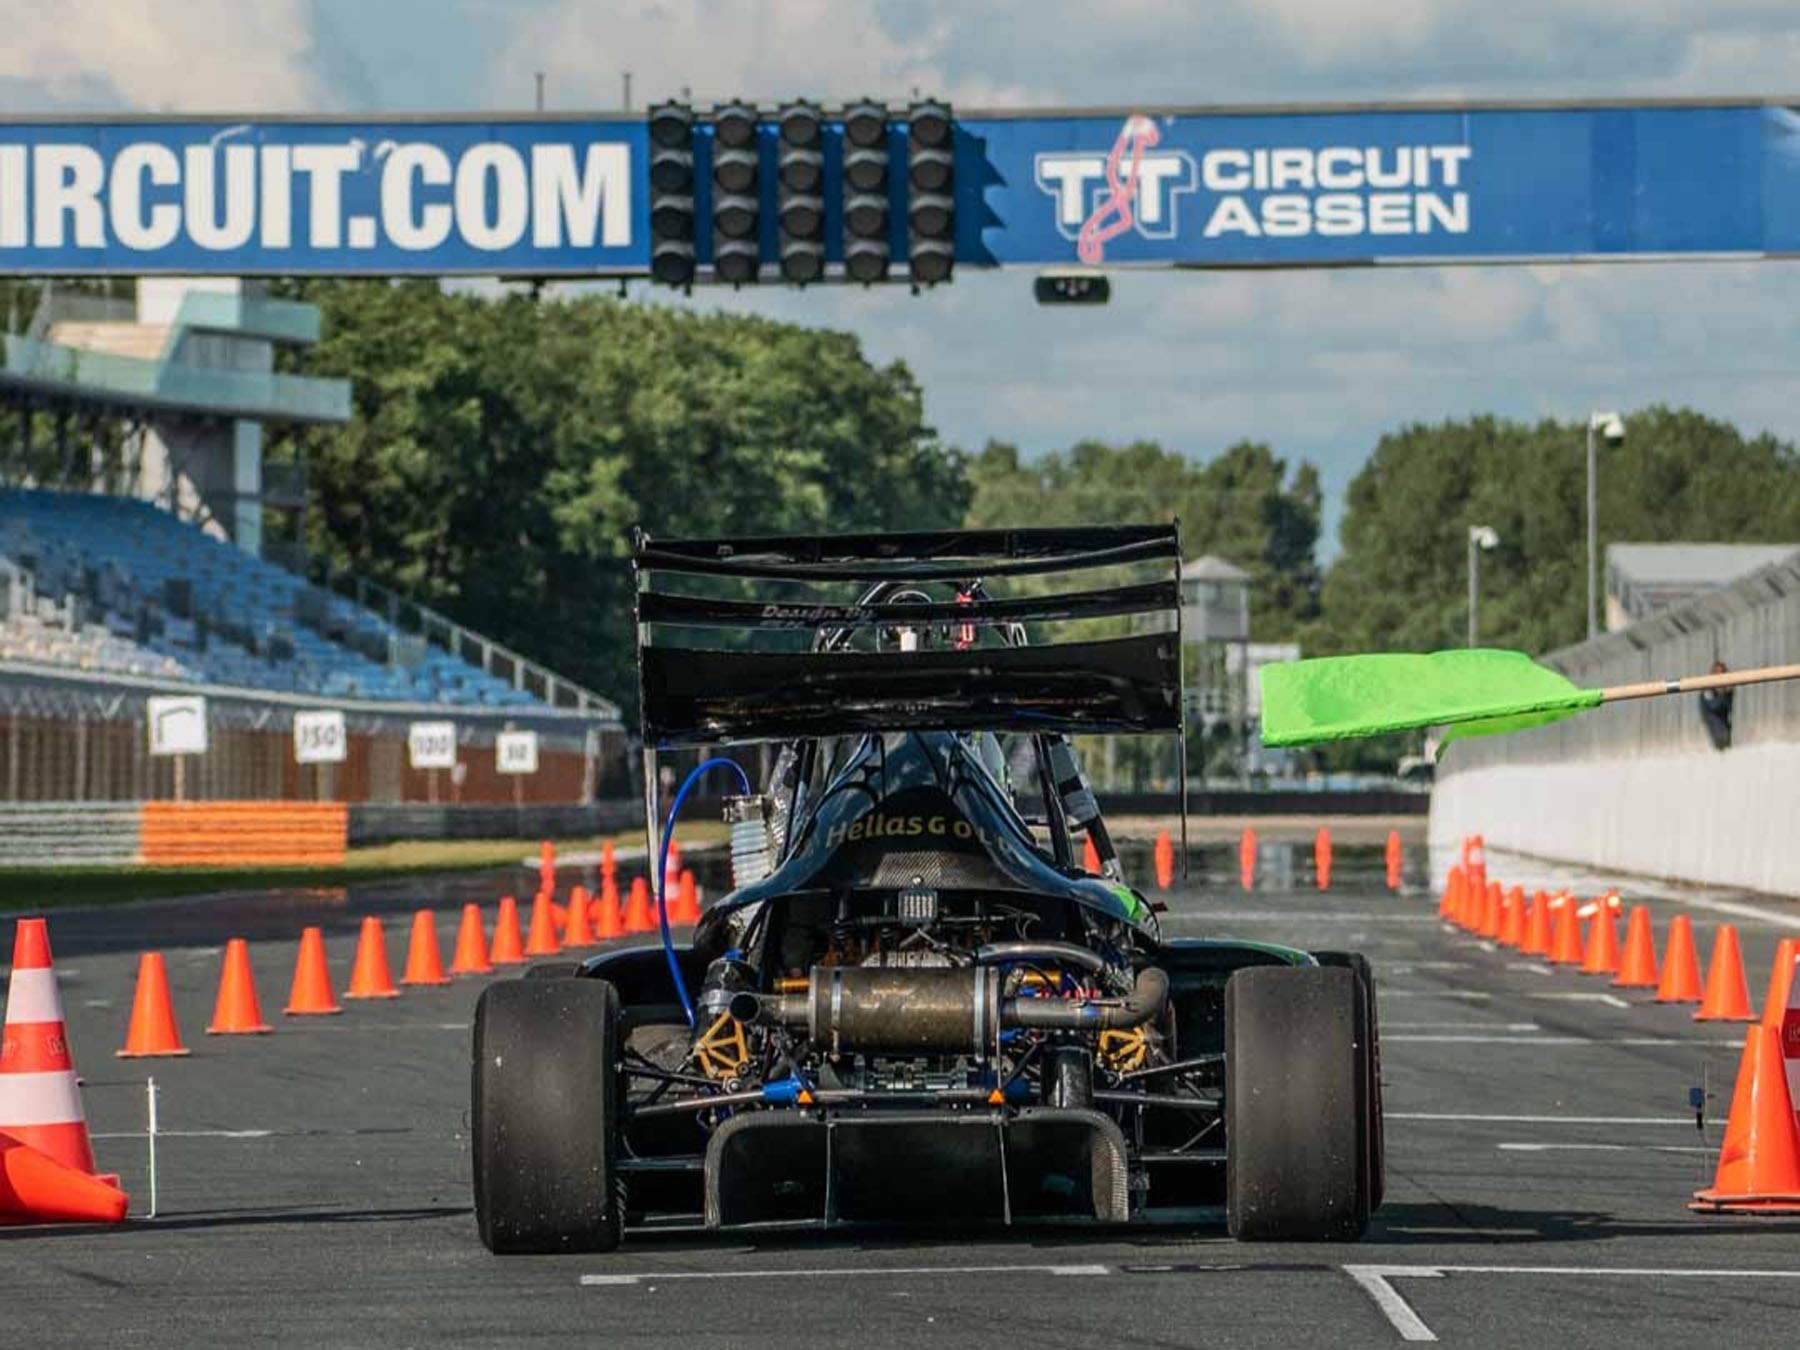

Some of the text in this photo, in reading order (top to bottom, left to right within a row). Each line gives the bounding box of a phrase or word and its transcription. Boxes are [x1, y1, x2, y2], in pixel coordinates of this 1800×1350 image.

[1203, 146, 1472, 190] CIRCUIT
[1203, 194, 1469, 237] ASSEN
[302, 724, 338, 749] 150
